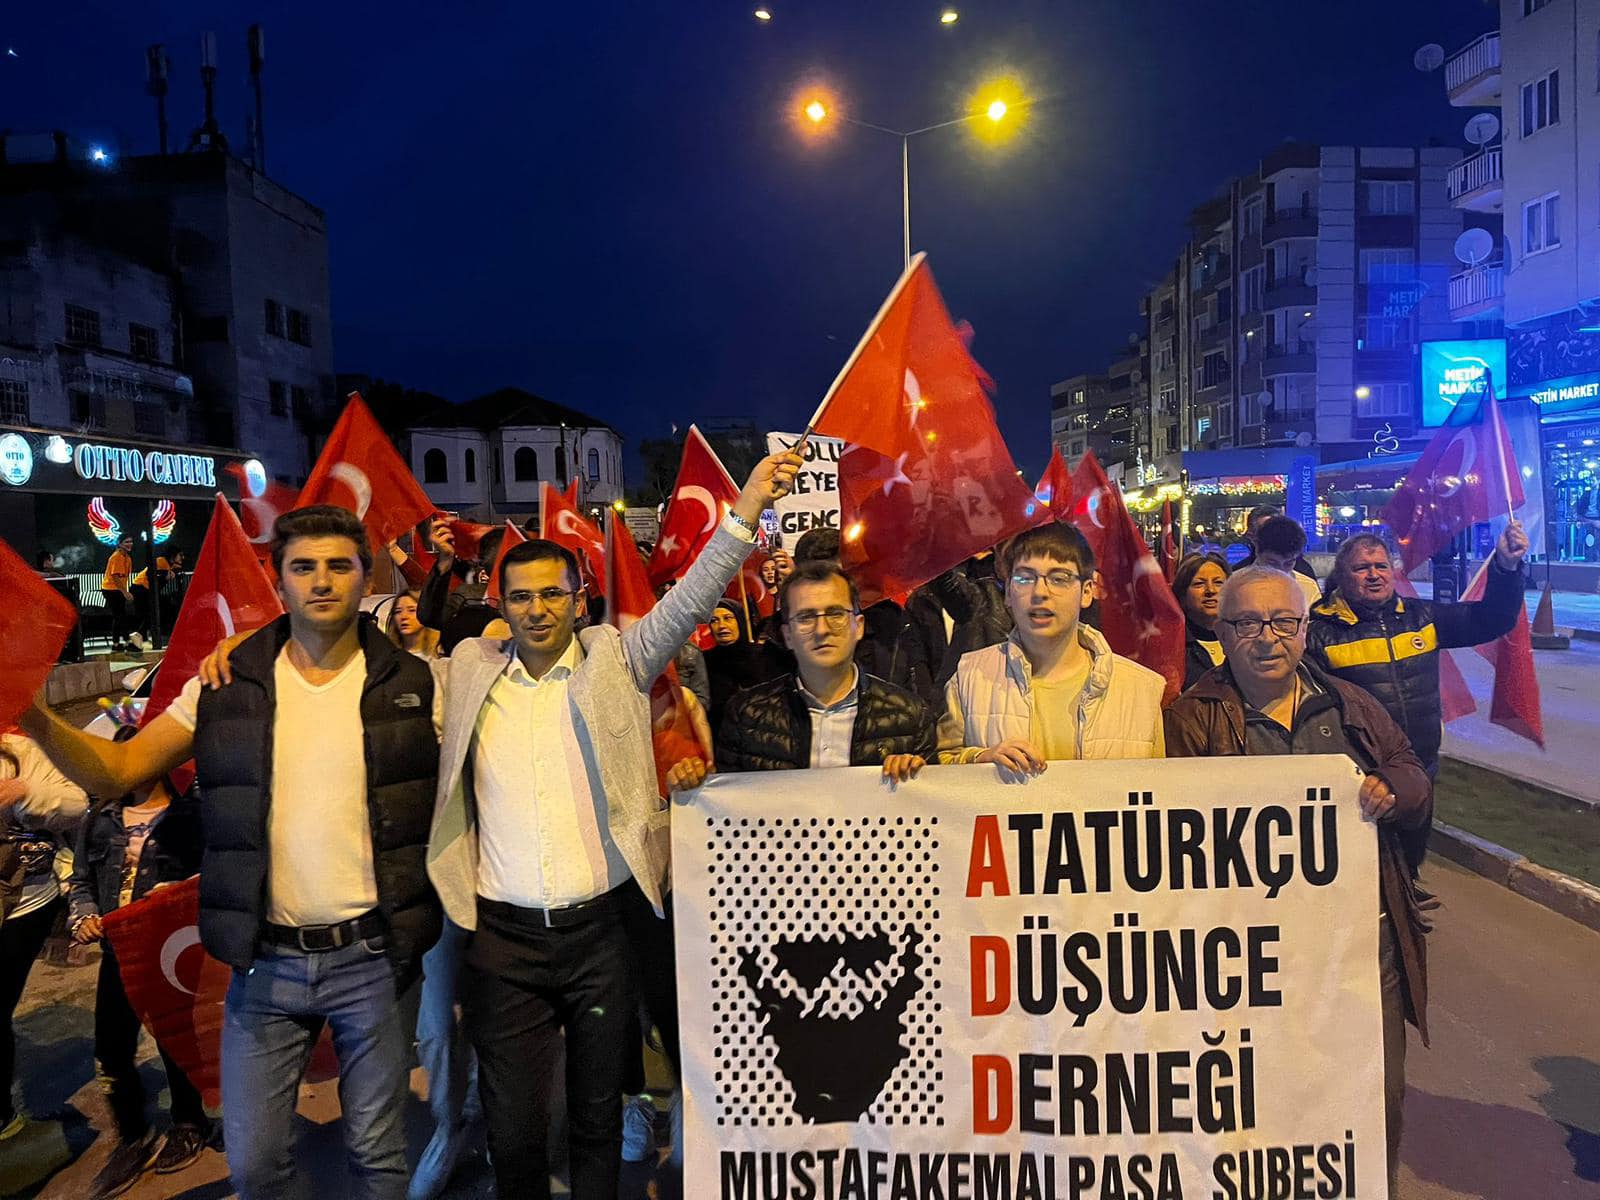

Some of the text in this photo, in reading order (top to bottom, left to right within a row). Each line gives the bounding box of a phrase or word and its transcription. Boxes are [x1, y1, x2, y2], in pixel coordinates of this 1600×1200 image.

[1559, 383, 1599, 400] MARKET
[6, 451, 24, 461] OTTO
[75, 443, 216, 487] OTTO CAFFE
[791, 471, 837, 494] EYE
[1302, 466, 1312, 503] MARKET
[966, 788, 1339, 898] ATATÜRKÇÜ
[970, 913, 1282, 1027] DÜŞÜNCE
[972, 1028, 1255, 1135] DERNEĞİ
